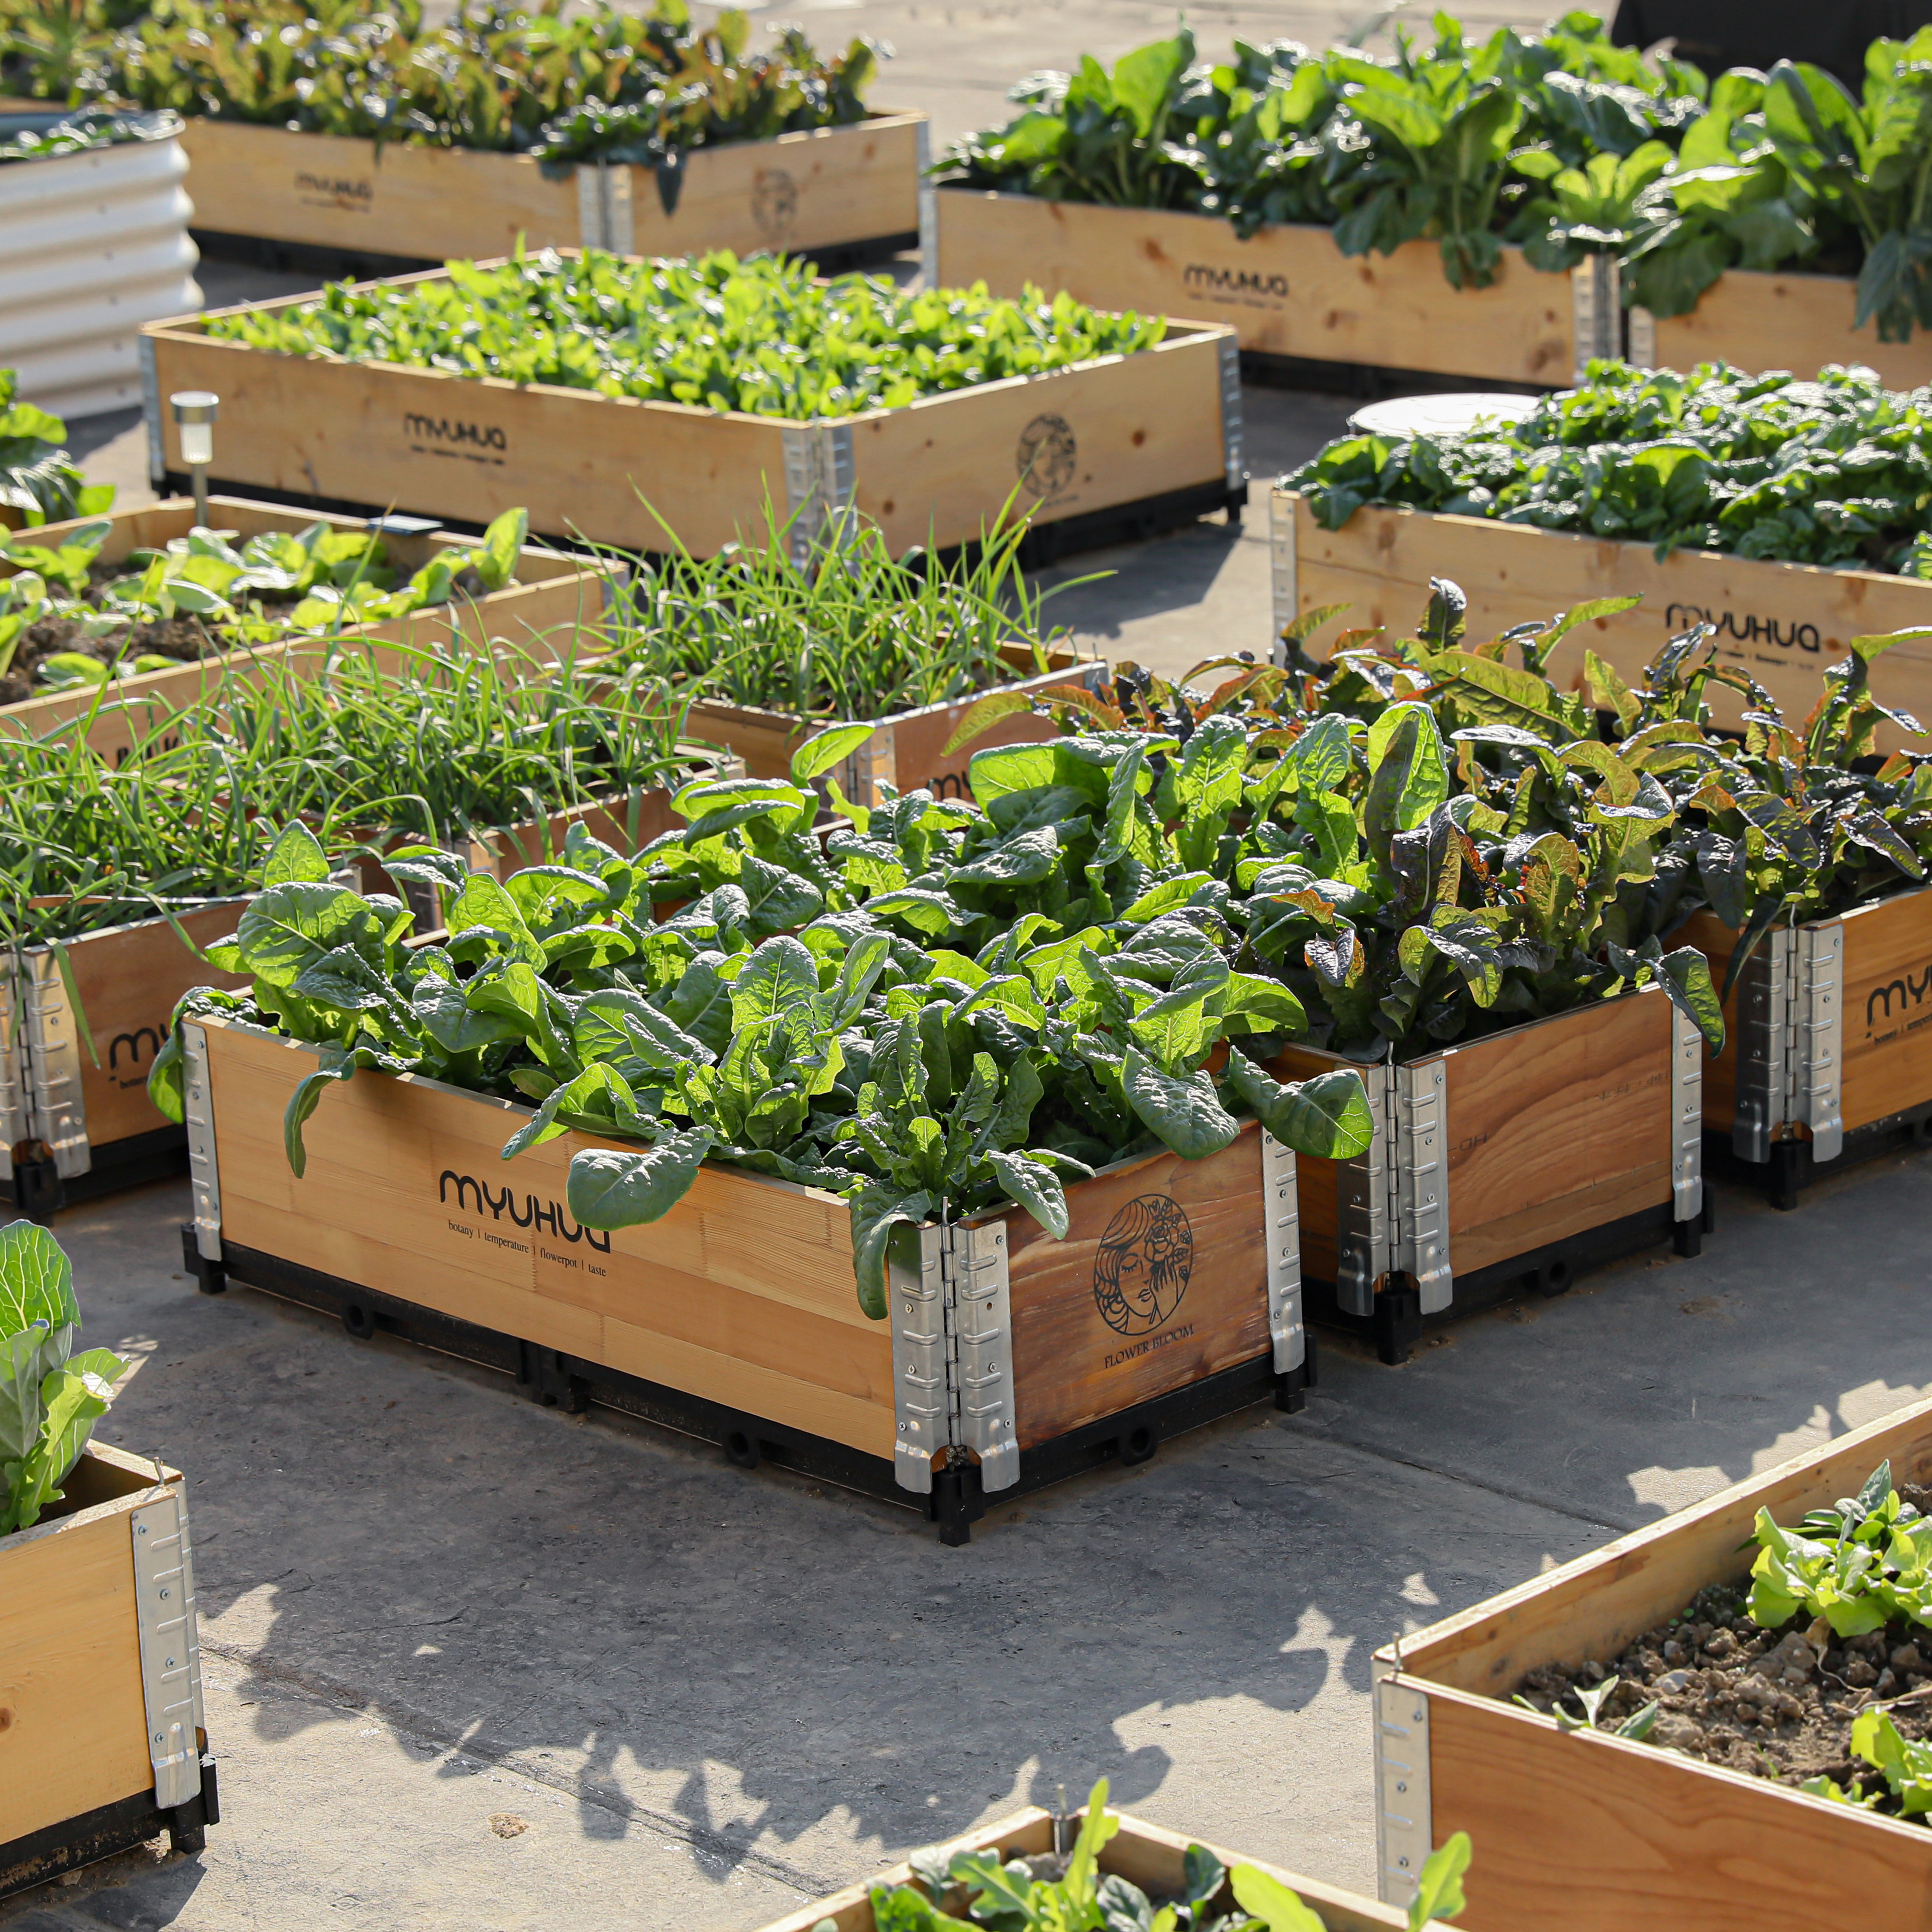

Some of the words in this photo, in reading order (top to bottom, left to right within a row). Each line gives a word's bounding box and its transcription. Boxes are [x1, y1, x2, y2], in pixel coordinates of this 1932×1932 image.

[448, 1220, 474, 1239] botany
[485, 1232, 529, 1253] temperature
[540, 1248, 577, 1268] flowerpot
[589, 1264, 606, 1277] taste
[1104, 1341, 1149, 1369] FLOWER
[1153, 1324, 1193, 1349] BLOOM
